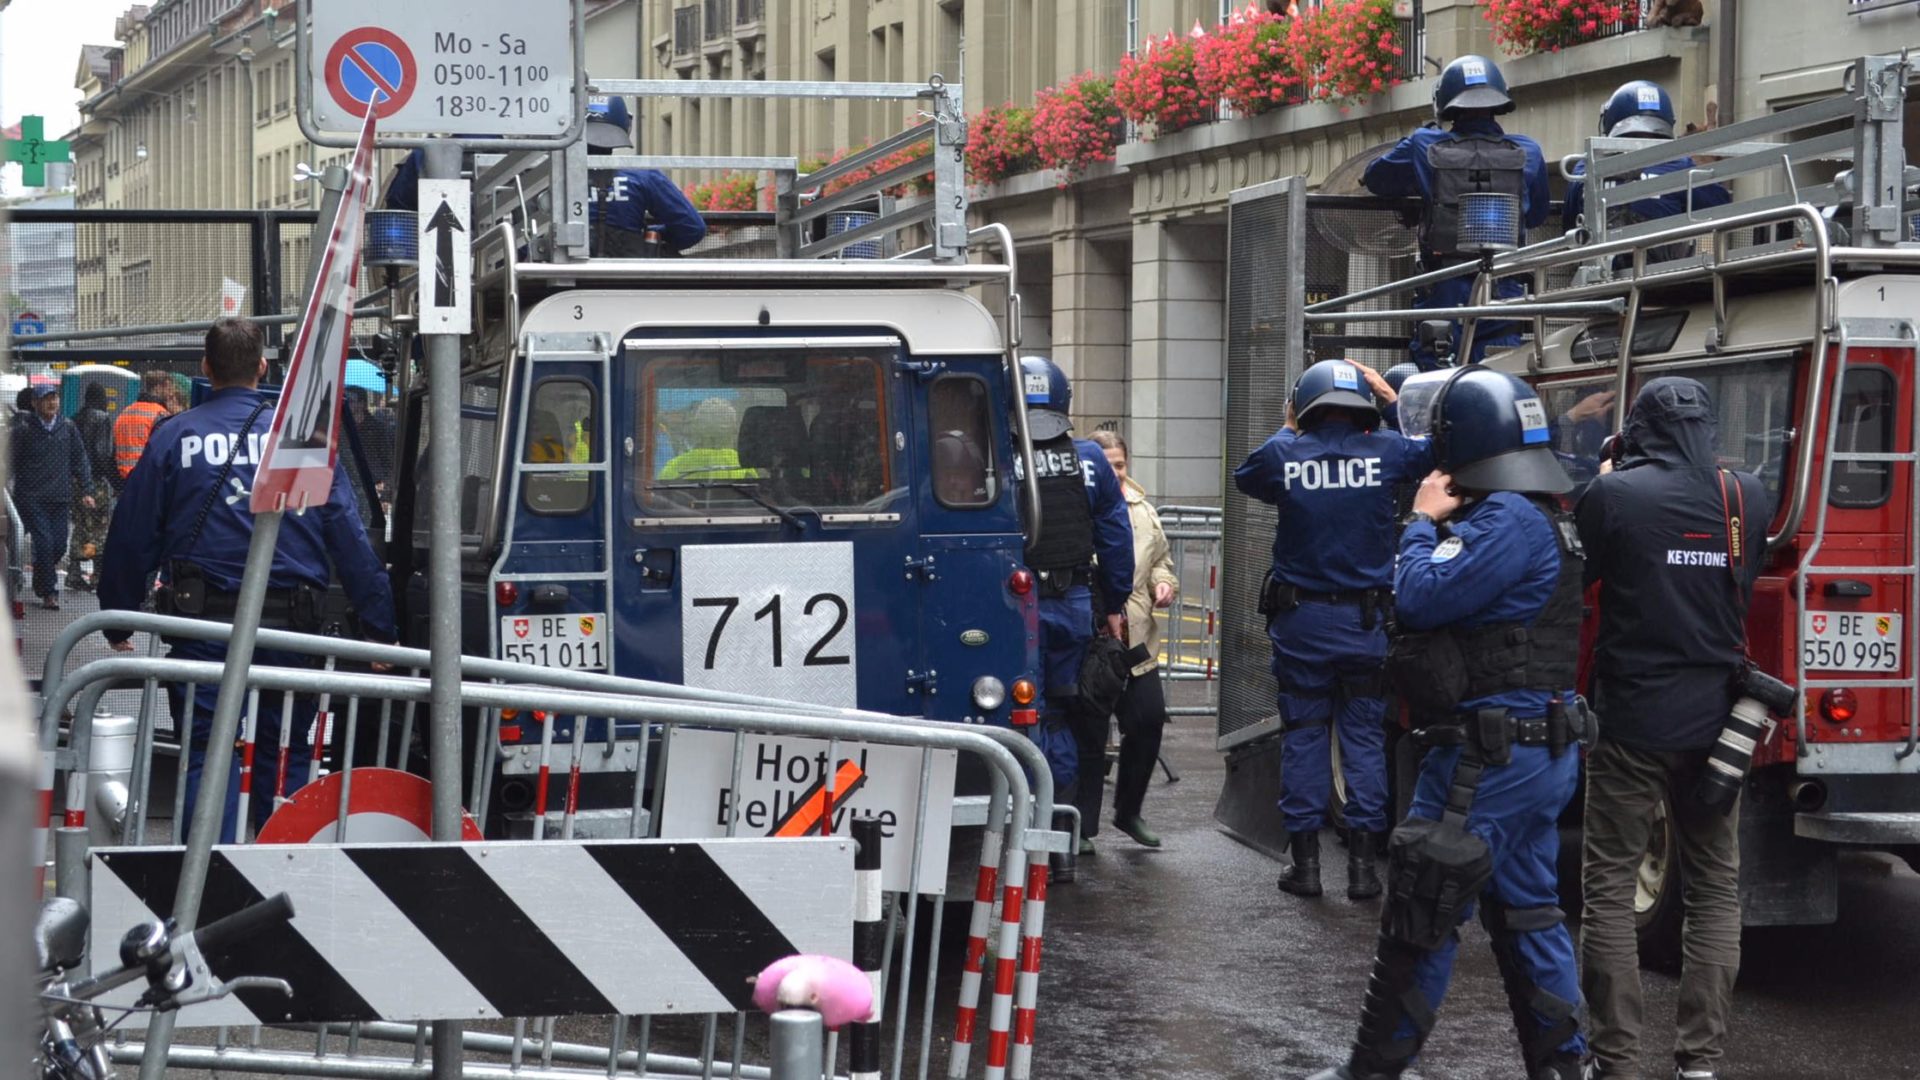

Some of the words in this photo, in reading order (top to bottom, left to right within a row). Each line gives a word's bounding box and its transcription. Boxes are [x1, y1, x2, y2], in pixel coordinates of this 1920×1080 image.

[434, 32, 472, 54] Mo
[499, 33, 526, 55] Sa
[954, 148, 963, 163] 3
[954, 194, 963, 210] 2
[1886, 185, 1894, 201] 1
[572, 201, 584, 217] 3
[1877, 286, 1885, 302] 1
[573, 304, 584, 321] 3
[181, 432, 269, 468] POLI
[1284, 457, 1382, 491] POLICE
[1730, 516, 1740, 557] Canon
[1666, 549, 1728, 567] KEYSTONE
[542, 617, 567, 638] BE
[692, 592, 850, 670] 712
[1840, 615, 1864, 636] BE
[506, 643, 551, 667] 551
[559, 641, 603, 668] 011
[1804, 640, 1846, 667] 550
[1853, 642, 1897, 669] 995
[755, 743, 868, 789] Hotl
